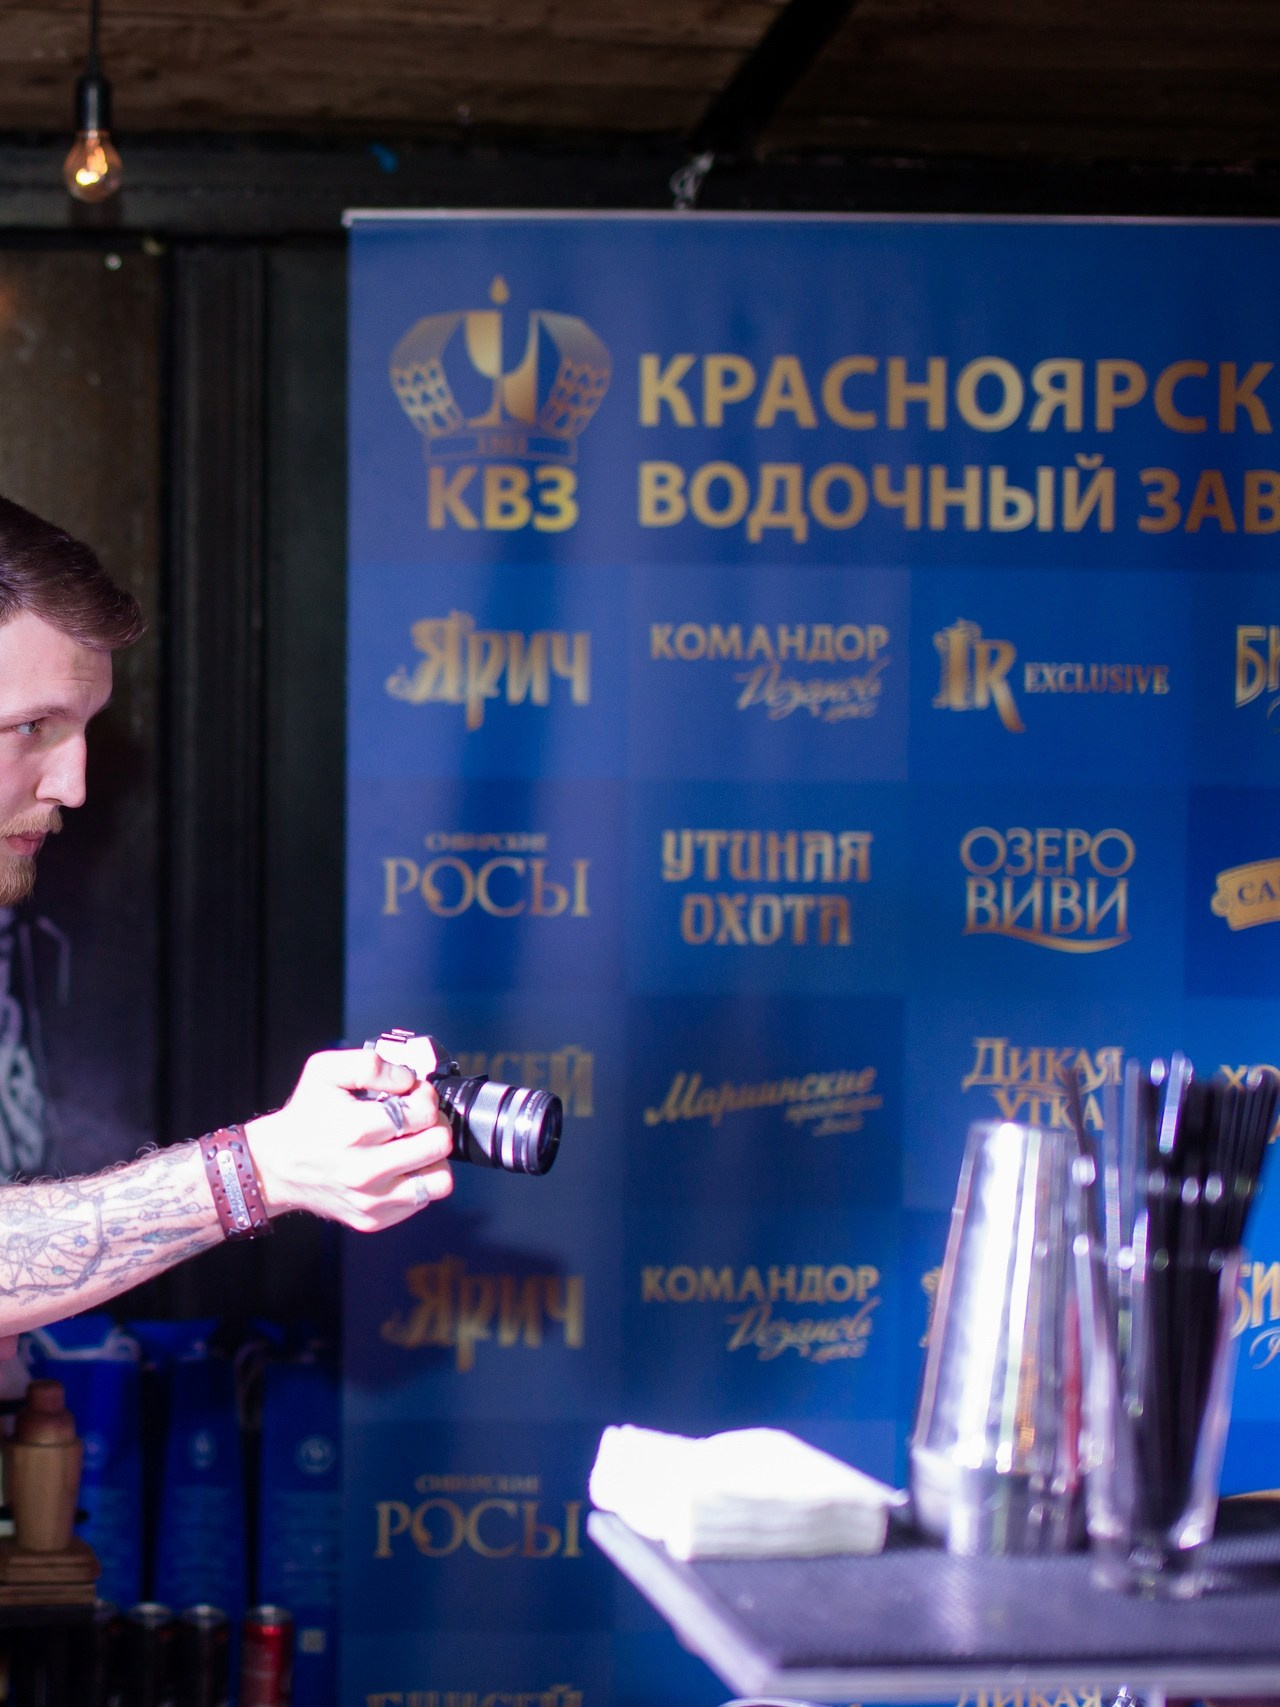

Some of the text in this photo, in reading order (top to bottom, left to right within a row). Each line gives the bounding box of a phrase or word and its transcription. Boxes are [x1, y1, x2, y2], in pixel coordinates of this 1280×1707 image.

[639, 353, 1275, 433] КРАСНОЯРСК
[427, 464, 579, 532] КВЗ
[639, 453, 1280, 543] ВОДОЧНЫЙ ЗАВ
[650, 622, 890, 664] КОМАНДОР
[1024, 661, 1170, 695] EXCLUSIVE
[661, 829, 873, 882] УТИНАЯ
[960, 826, 1136, 876] ОЗЕРО
[382, 856, 591, 917] РОСЫ
[964, 876, 1130, 936] ВИВИ
[681, 893, 852, 945] ОХОТА
[641, 1265, 879, 1304] КОМАНДОР
[374, 1498, 583, 1559] РОСЫ
